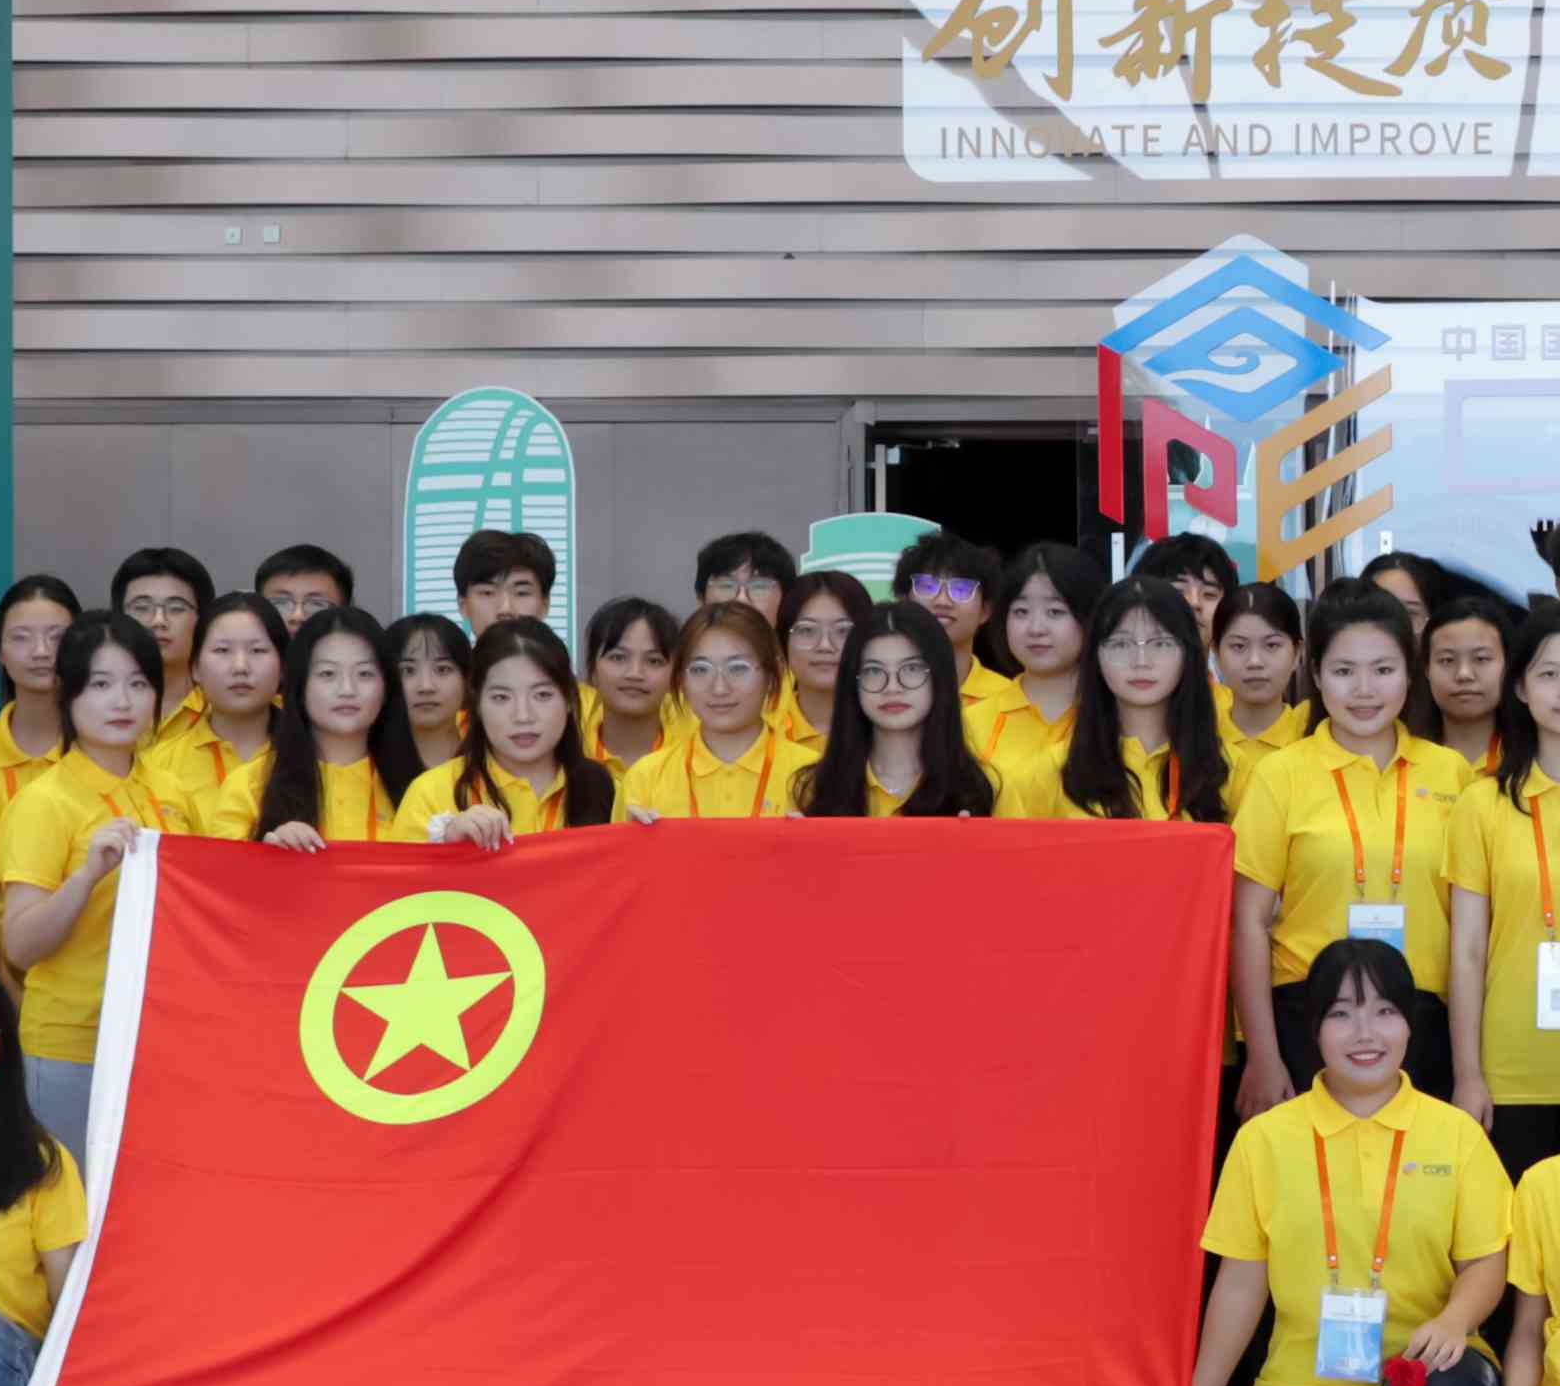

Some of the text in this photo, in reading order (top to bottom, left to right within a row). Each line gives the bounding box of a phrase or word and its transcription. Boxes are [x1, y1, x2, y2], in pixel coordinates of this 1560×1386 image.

[940, 122, 1495, 159] INNOVATE AND IMPROVE
